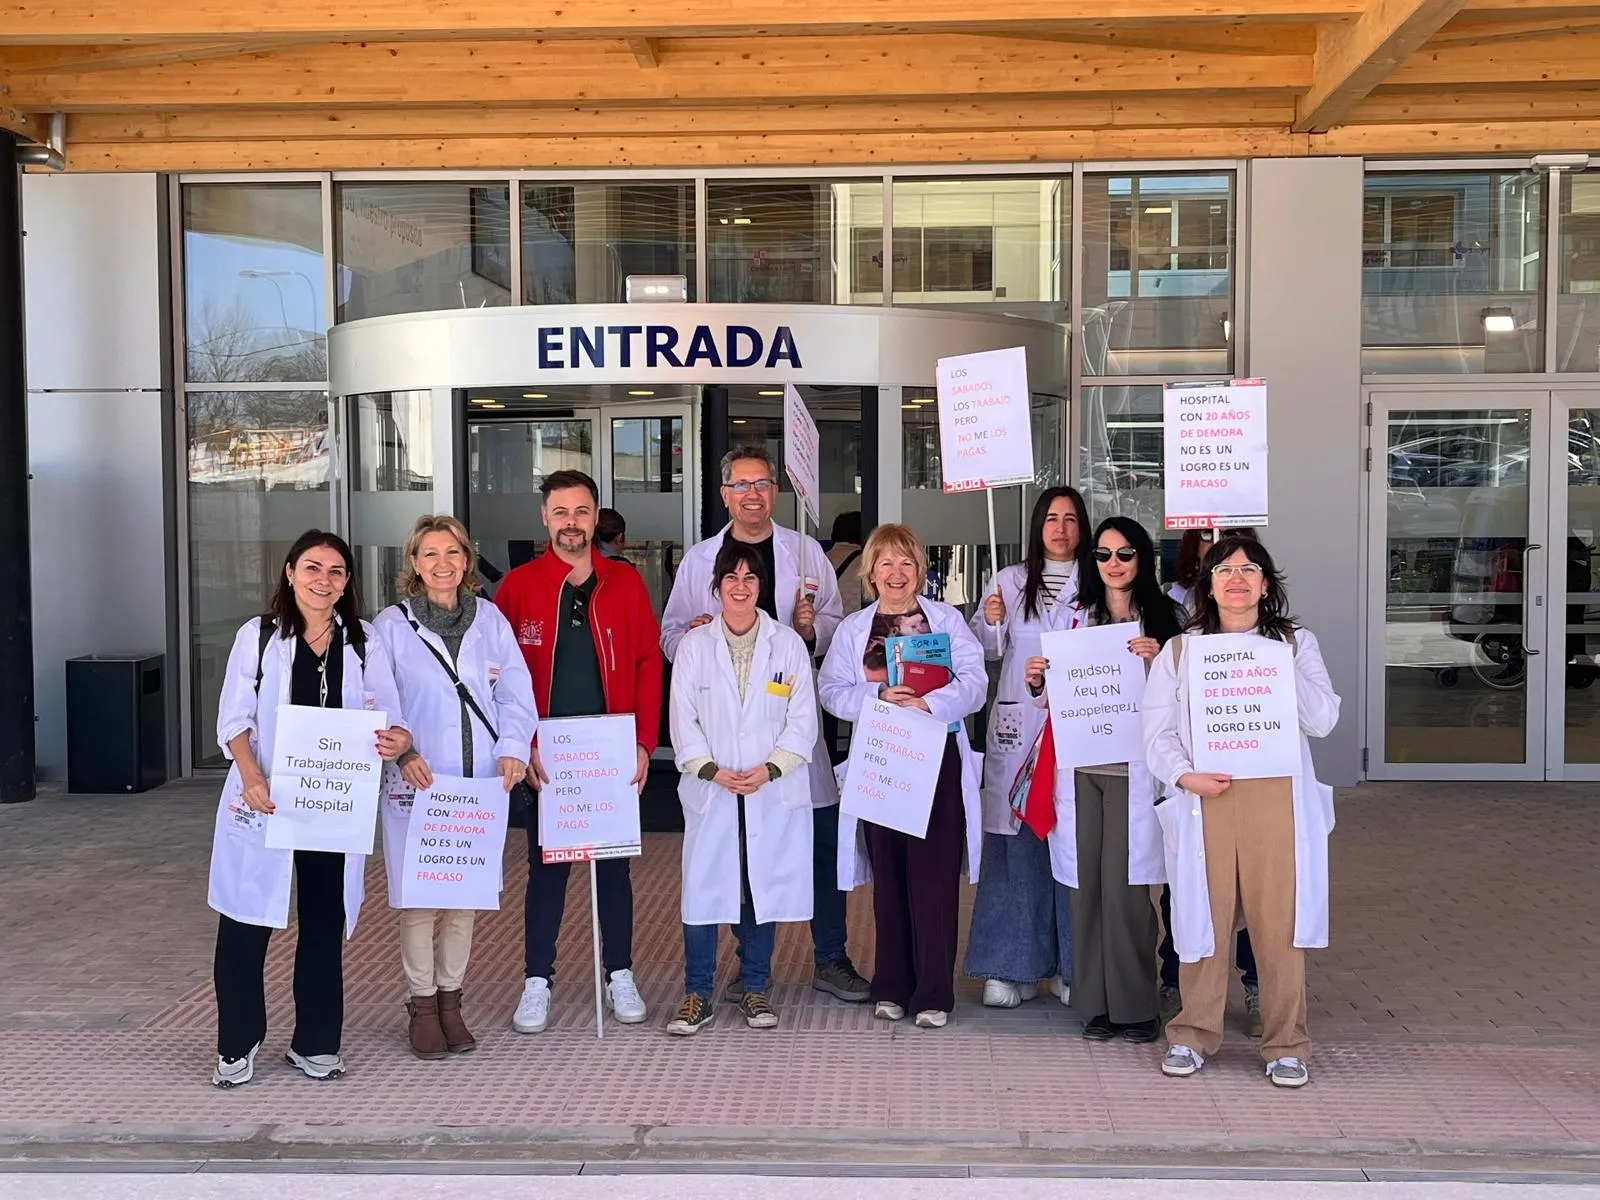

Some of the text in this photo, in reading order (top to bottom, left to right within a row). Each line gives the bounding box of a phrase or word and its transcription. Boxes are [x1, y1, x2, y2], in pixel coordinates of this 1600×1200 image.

[538, 326, 803, 369] ENTRADA
[951, 369, 967, 378] LOS
[952, 382, 992, 395] SABADOS
[954, 396, 1011, 411] LOS TRABAJO
[1180, 395, 1230, 405] HOSPITAL
[955, 416, 978, 426] PERO
[1180, 409, 1250, 422] CON 20 AÑOS
[958, 428, 1007, 442] NO ME LOS
[1180, 428, 1243, 438] DE DEMORA
[957, 446, 986, 458] PAGAS
[1180, 445, 1232, 455] NO ES UN
[1180, 462, 1250, 471] LOGRO ES UN
[1180, 479, 1228, 488] FRACASO
[911, 639, 939, 648] SORIA
[1204, 652, 1255, 664] HOSPITAL
[1068, 664, 1121, 680] Hospital
[1204, 666, 1277, 680] CON 20 AÑOS
[1074, 684, 1121, 697] No hay
[1205, 686, 1272, 698] DE DEMORA
[874, 703, 890, 714] LOS
[1061, 702, 1139, 718] Trabajadores
[1206, 704, 1261, 714] NO ES UN
[871, 721, 912, 739] SABADOS
[1092, 723, 1112, 735] Sin
[1207, 721, 1280, 733] LOGRO ES UN
[318, 738, 341, 751] Sin
[553, 735, 571, 744] LOS
[1208, 740, 1258, 751] FRACASO
[867, 736, 925, 761] LOS TRABAJO
[554, 752, 600, 762] SABADOS
[864, 752, 887, 766] PERO
[286, 756, 371, 772] Trabajadores
[555, 768, 618, 780] LOS TRABAJO
[300, 777, 352, 794] No hay
[862, 770, 911, 792] NO ME LOS
[556, 787, 581, 796] PERO
[858, 785, 886, 800] PAGAS
[295, 797, 353, 812] Hospital
[430, 792, 480, 805] HOSPITAL
[559, 802, 614, 813] NO ME LOS
[427, 808, 496, 820] CON 20 AÑOS
[423, 823, 486, 834] DE DEMORA
[557, 820, 589, 829] PAGAS
[420, 838, 472, 848] NO ES UN
[419, 854, 453, 864] LOGRO
[457, 856, 468, 864] ES
[417, 872, 463, 881] FRACASO
